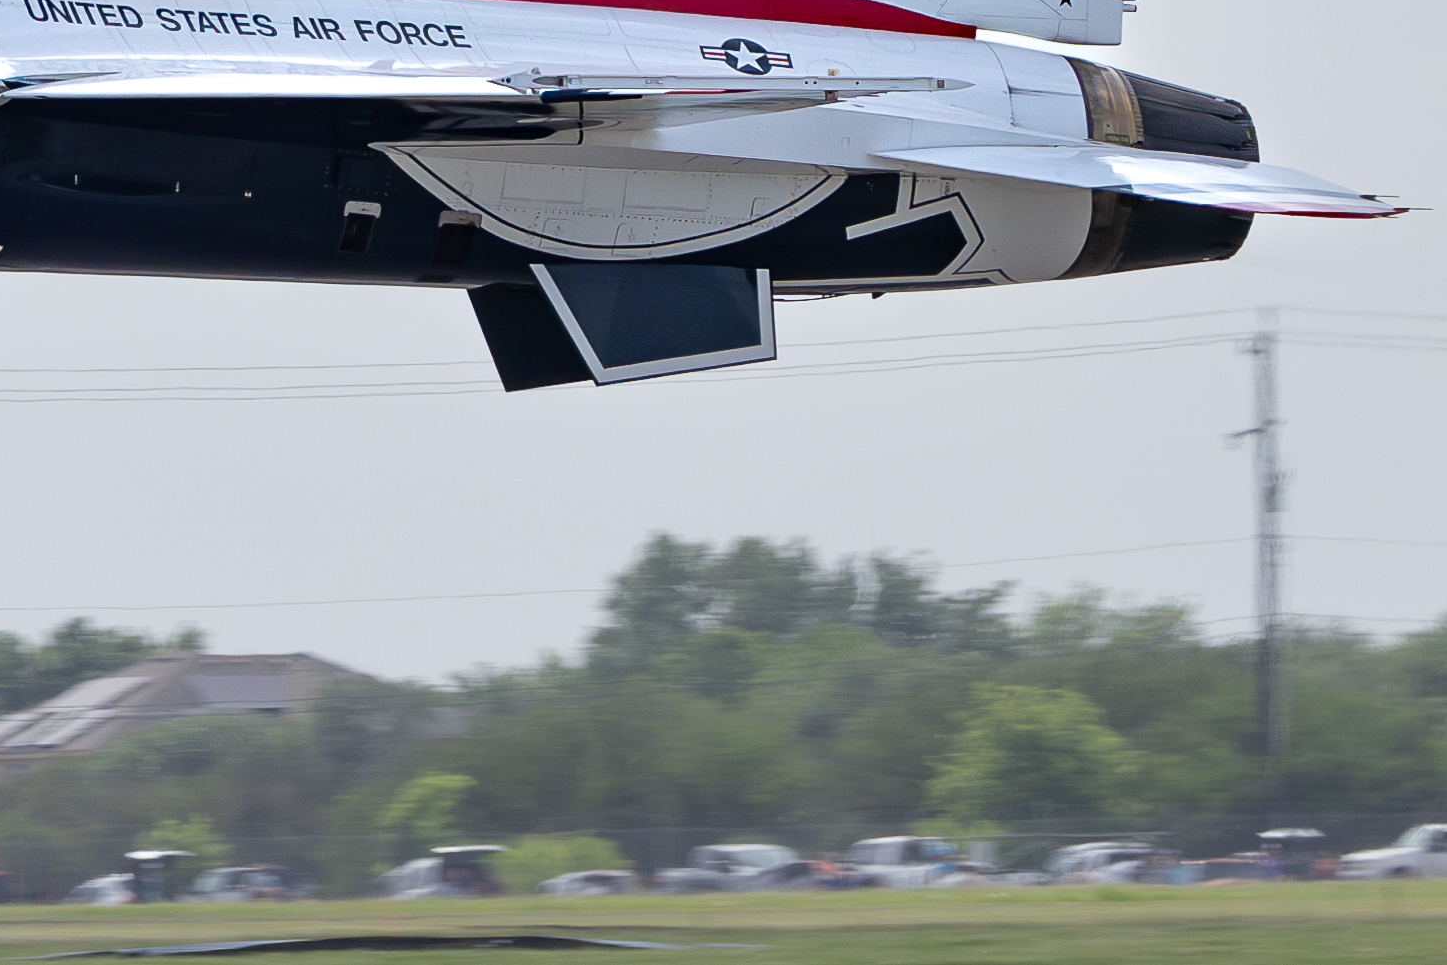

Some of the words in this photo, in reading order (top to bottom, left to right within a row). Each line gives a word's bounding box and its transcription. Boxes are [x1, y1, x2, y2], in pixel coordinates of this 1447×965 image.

[156, 8, 277, 37] STATES
[292, 16, 347, 41] AIR
[355, 20, 472, 48] FORCE
